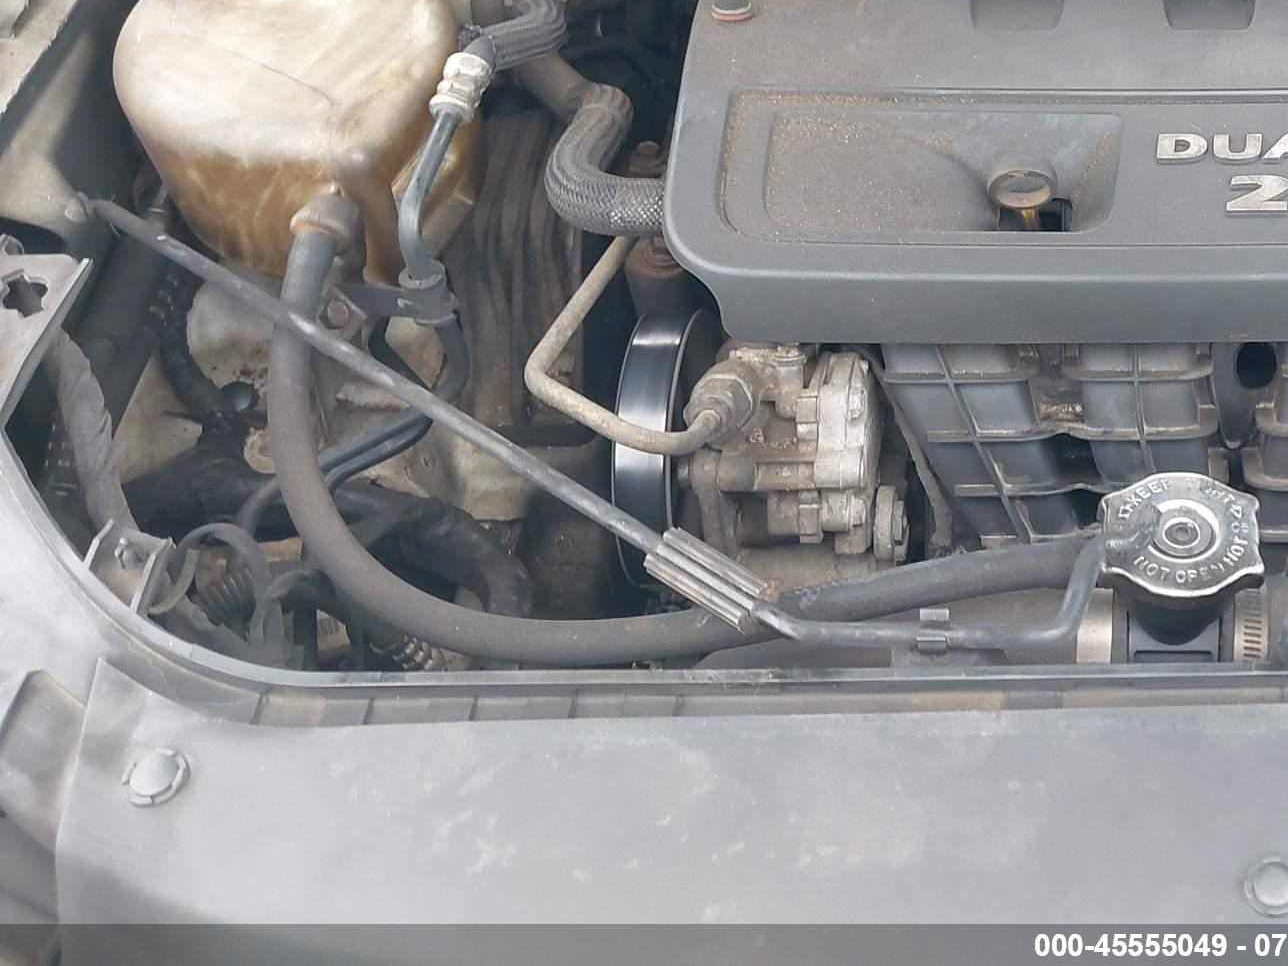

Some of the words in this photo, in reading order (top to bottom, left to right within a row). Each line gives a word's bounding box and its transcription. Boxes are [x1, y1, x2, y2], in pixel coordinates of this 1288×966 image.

[1127, 478, 1173, 506] KEEP
[1133, 555, 1171, 580] NOT
[1175, 562, 1225, 583] OPEN
[1223, 535, 1249, 566] HOT
